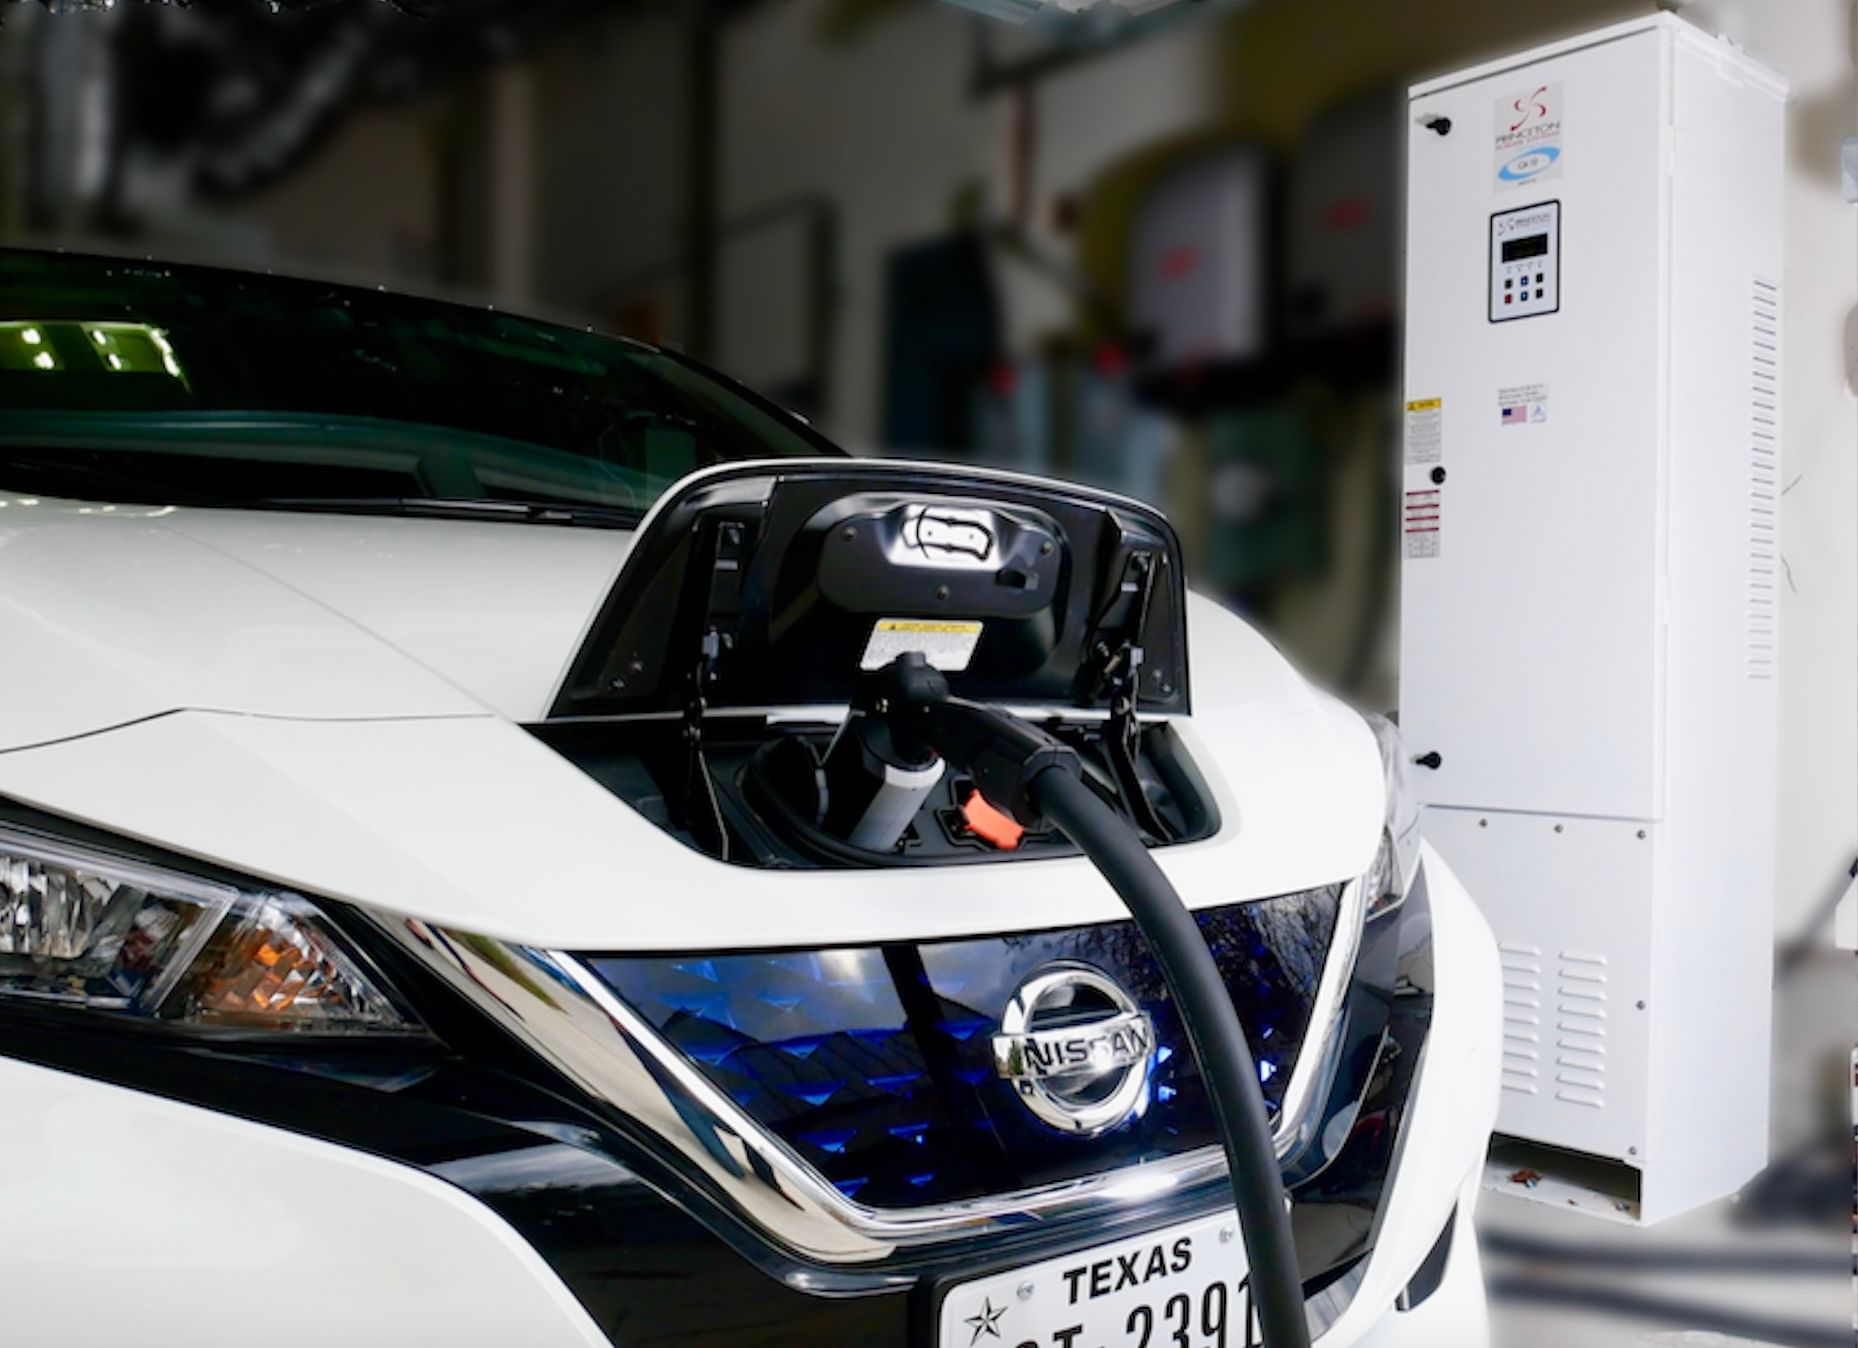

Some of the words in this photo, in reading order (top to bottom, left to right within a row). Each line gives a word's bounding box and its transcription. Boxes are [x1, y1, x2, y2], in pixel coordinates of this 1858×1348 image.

[1495, 120, 1560, 144] PRINCETON
[1023, 1023, 1148, 1067] NISSAN
[1063, 1237, 1192, 1305] TEXAS
